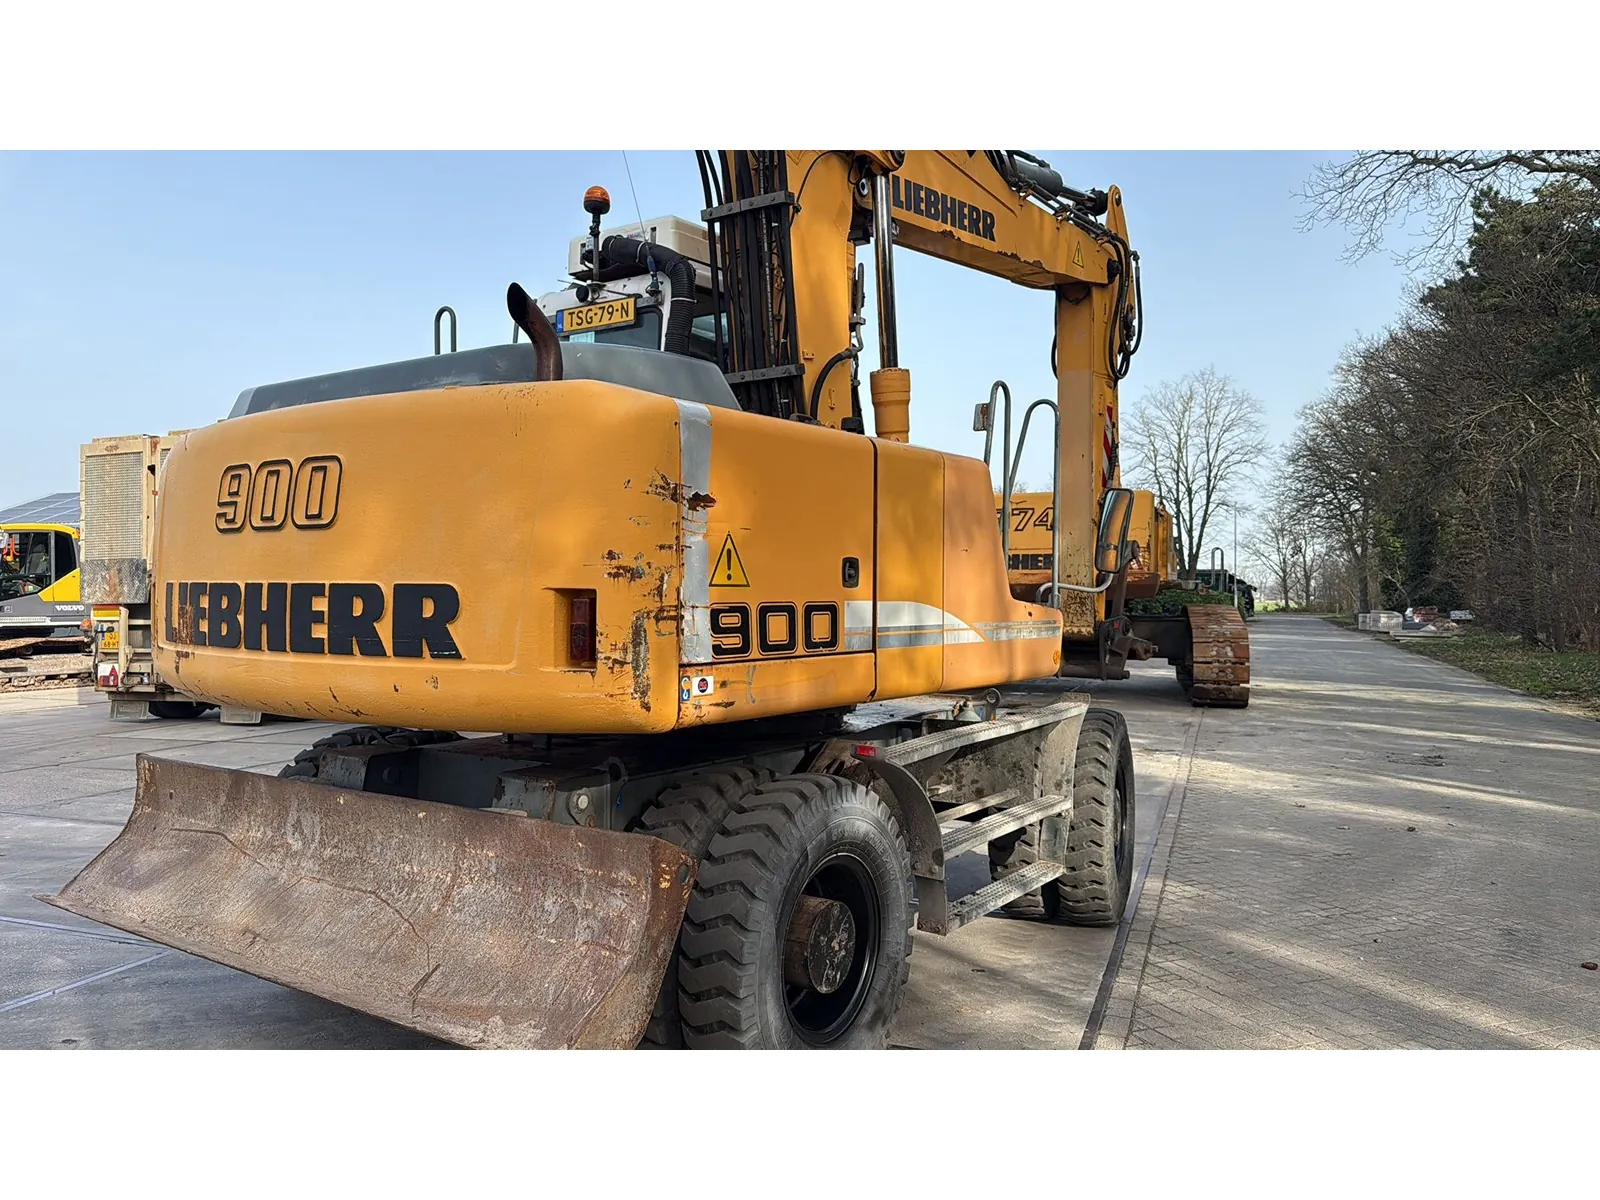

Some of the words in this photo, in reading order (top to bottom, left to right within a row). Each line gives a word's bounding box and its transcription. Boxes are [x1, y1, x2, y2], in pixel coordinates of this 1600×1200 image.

[892, 174, 996, 242] LIEBHERR
[568, 301, 629, 328] TSG-79-N
[215, 454, 343, 534] 900
[996, 506, 1054, 531] 74
[165, 582, 465, 659] LIEBHERR
[709, 601, 840, 660] 900
